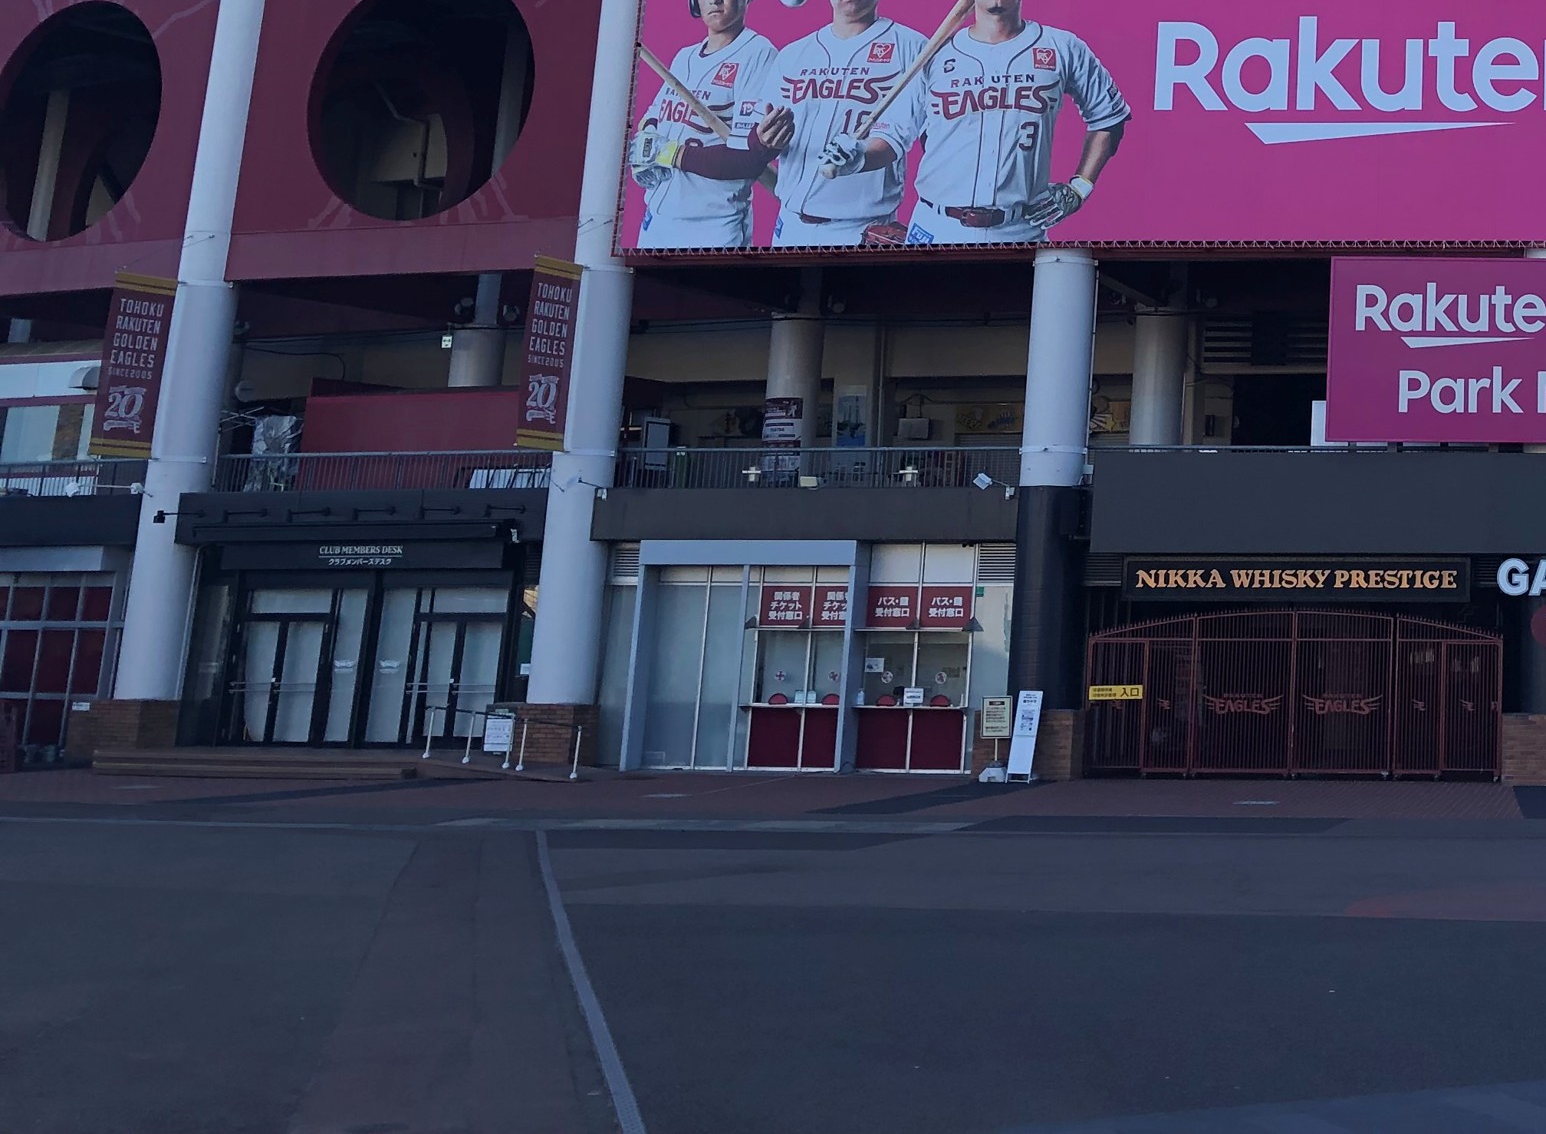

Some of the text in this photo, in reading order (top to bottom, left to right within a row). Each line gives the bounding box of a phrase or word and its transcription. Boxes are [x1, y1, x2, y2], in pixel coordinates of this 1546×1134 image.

[800, 67, 870, 76] RAKUTEN
[950, 74, 1035, 88] RAKUTEN
[783, 74, 890, 105] EAGLES
[932, 83, 1054, 120] EAGLES
[1018, 121, 1040, 151] 3
[537, 282, 573, 303] TOHOKU
[120, 298, 164, 318] TOHOKU
[534, 300, 571, 320] RAKUTEN
[116, 315, 162, 334] RAKUTEN
[531, 318, 568, 338] GOLDEN
[113, 332, 158, 351] GOLDEN
[529, 336, 566, 356] EAGLES
[110, 349, 155, 368] EAGLES
[1399, 366, 1524, 414] Park
[319, 545, 403, 555] CLUB MEMBERS DESK
[1135, 569, 1458, 590] NIKKA WHISKY PRESTIGE
[770, 601, 802, 611] チケット
[1120, 687, 1140, 697] 入口
